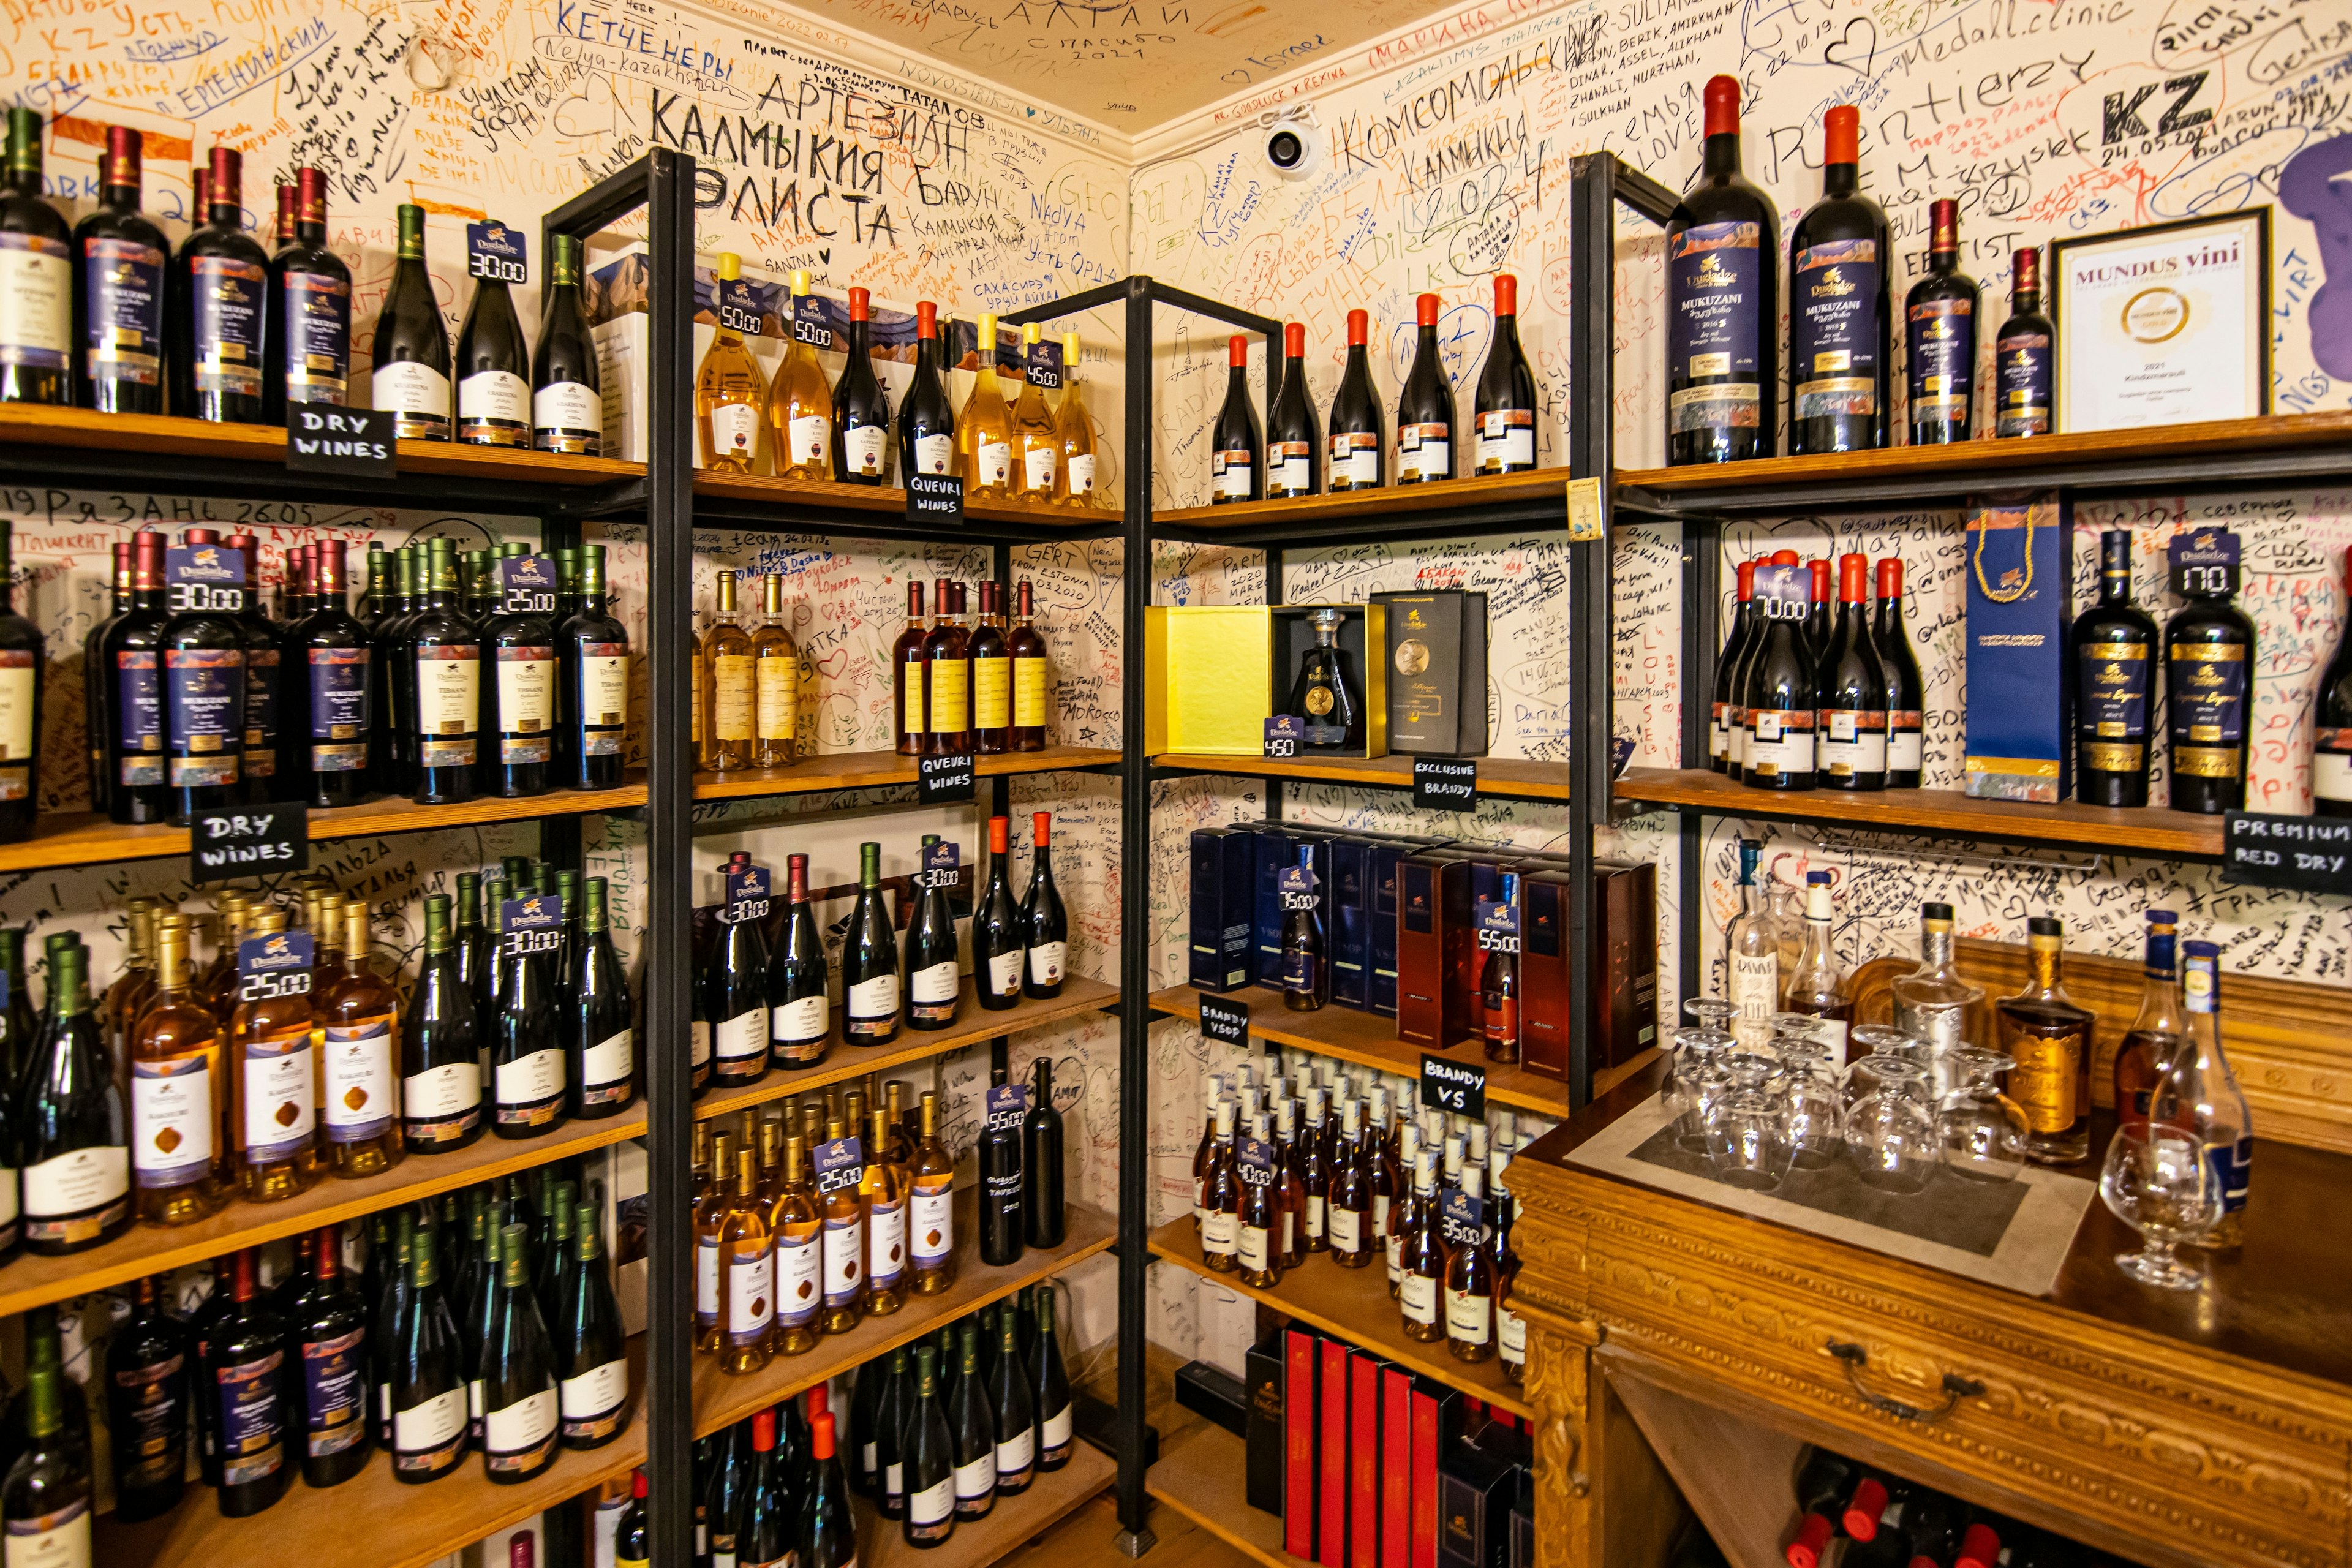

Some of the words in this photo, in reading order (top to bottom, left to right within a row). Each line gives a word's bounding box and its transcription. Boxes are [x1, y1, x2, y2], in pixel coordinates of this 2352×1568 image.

[557, 0, 734, 82] КЕТЧЕНЕРЫ
[1667, 23, 1723, 55] ALIKHAN
[1231, 88, 1287, 119] GOODLUCK
[2101, 70, 2213, 146] KZ
[756, 74, 968, 176] АРТЕЗИАН
[650, 88, 883, 195] КАЛМЫКИЯ
[1403, 110, 1531, 190] КАЛМЫКИЯ
[694, 167, 901, 250] ЭЛИСТА
[470, 253, 525, 282] 30.00
[2076, 256, 2178, 287] MUNDUS
[2185, 241, 2242, 268] vini
[1681, 293, 1742, 312] MUKUZANI
[1806, 300, 1862, 317] MUKUZANI
[722, 305, 761, 334] 50.00
[796, 322, 831, 347] 50.00
[1027, 366, 1058, 388] 45.00
[301, 412, 369, 434] DRY
[294, 437, 388, 460] WINES
[911, 477, 960, 496] QVEVRI
[917, 499, 957, 513] WINES
[780, 560, 788, 573] &
[791, 554, 820, 567] Dasha
[1026, 541, 1077, 568] GERT
[1011, 558, 1036, 571] FROM
[1041, 568, 1090, 592] ESTONIA
[1415, 567, 1468, 581] АБАКАН
[171, 583, 243, 611] 30.00
[507, 589, 555, 612] 25.00
[1056, 584, 1084, 600] 2020
[1755, 595, 1807, 620] 70.00
[1265, 739, 1295, 756] 450
[922, 756, 971, 774] QVEVRI
[1415, 763, 1474, 775] EXCLUSIVE
[928, 774, 971, 790] WINES
[1425, 782, 1472, 798] BRANDY
[203, 814, 274, 838] DRY
[2233, 819, 2351, 842] PREMIUM
[2235, 847, 2280, 867] RED
[2294, 852, 2345, 873] DRY
[925, 869, 959, 888] 30.00
[731, 900, 770, 924] 30.00
[504, 930, 559, 956] 30.00
[1478, 929, 1521, 953] 55.00
[243, 971, 311, 1001] 25.00
[1202, 1005, 1248, 1027] BRANDY
[1210, 1022, 1240, 1038] VSOP
[1425, 1061, 1485, 1090] BRANDY
[1437, 1086, 1464, 1109] VS
[988, 1109, 1025, 1133] 55.00
[819, 1167, 862, 1195] 25.00
[1236, 1163, 1272, 1186] 40.00
[1442, 1215, 1482, 1246] 35.00
